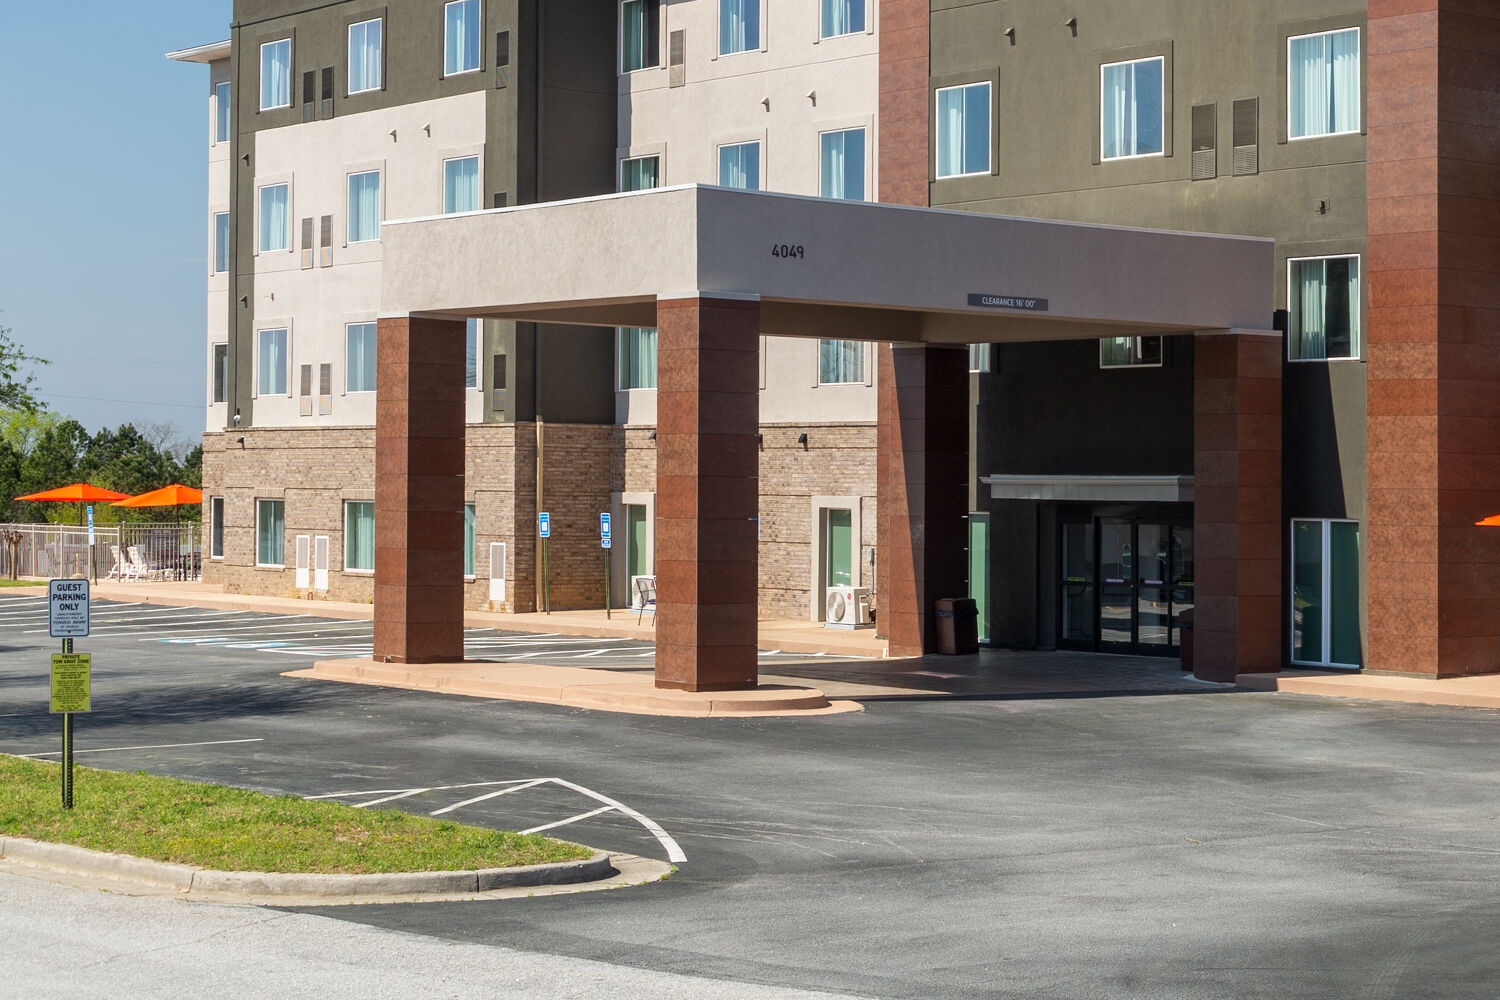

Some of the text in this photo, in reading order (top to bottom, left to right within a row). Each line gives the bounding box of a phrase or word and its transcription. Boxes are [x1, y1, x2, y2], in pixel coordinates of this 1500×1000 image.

[771, 244, 804, 259] 4049
[981, 296, 1015, 307] CLEARANCE
[59, 603, 79, 611] ONLY
